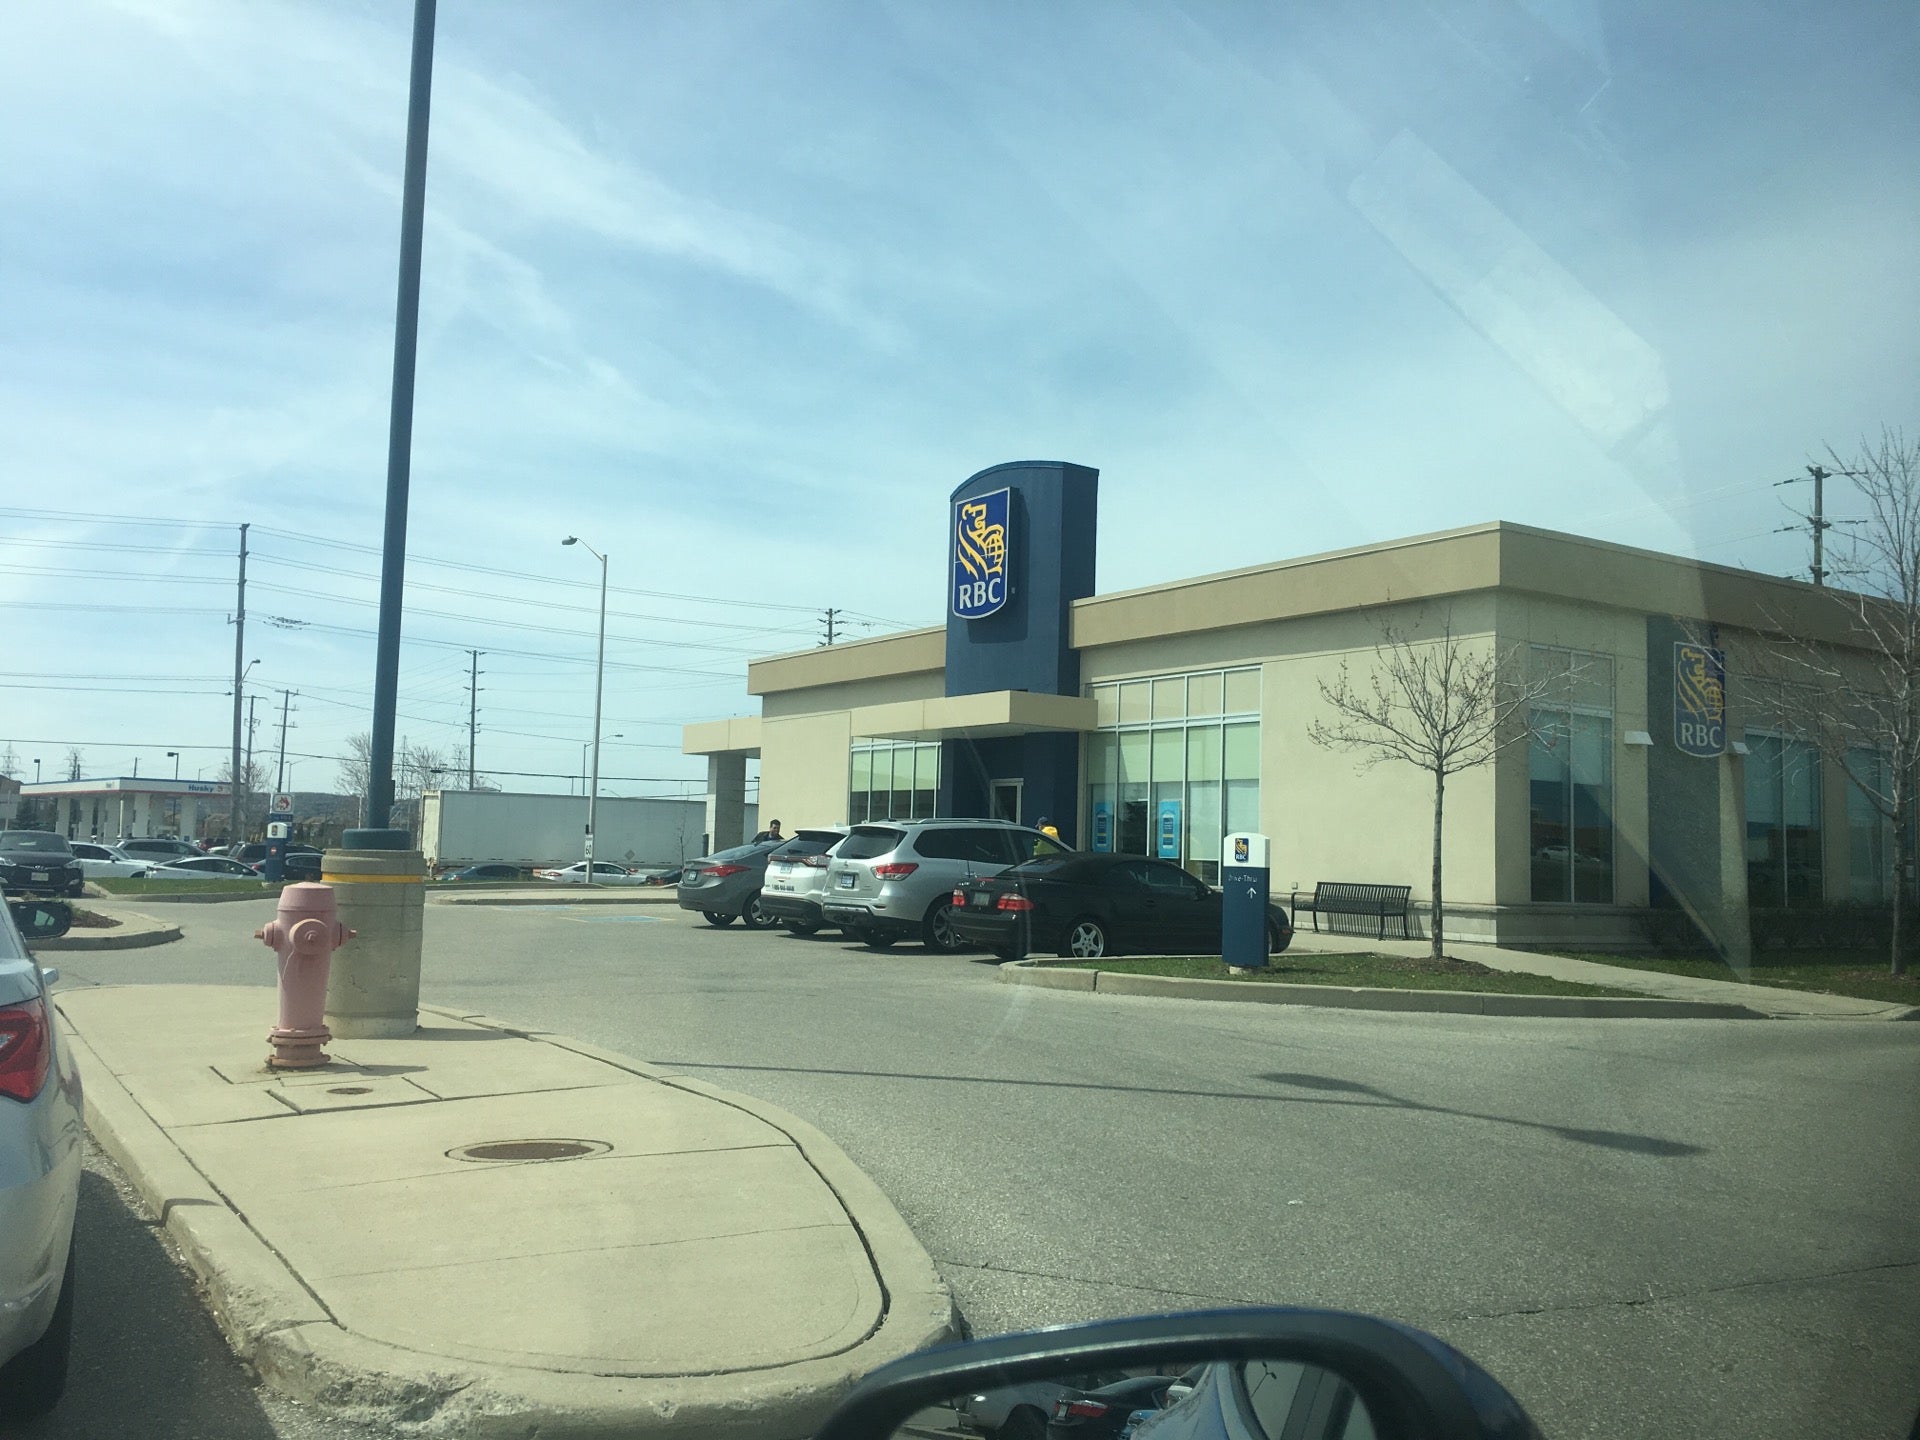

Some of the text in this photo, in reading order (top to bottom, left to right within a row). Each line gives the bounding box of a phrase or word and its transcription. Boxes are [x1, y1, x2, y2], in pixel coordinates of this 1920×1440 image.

[959, 577, 1001, 609] RBC
[1680, 722, 1721, 748] RBC
[188, 784, 214, 793] Husky
[1228, 874, 1258, 883] Dve-Thru
